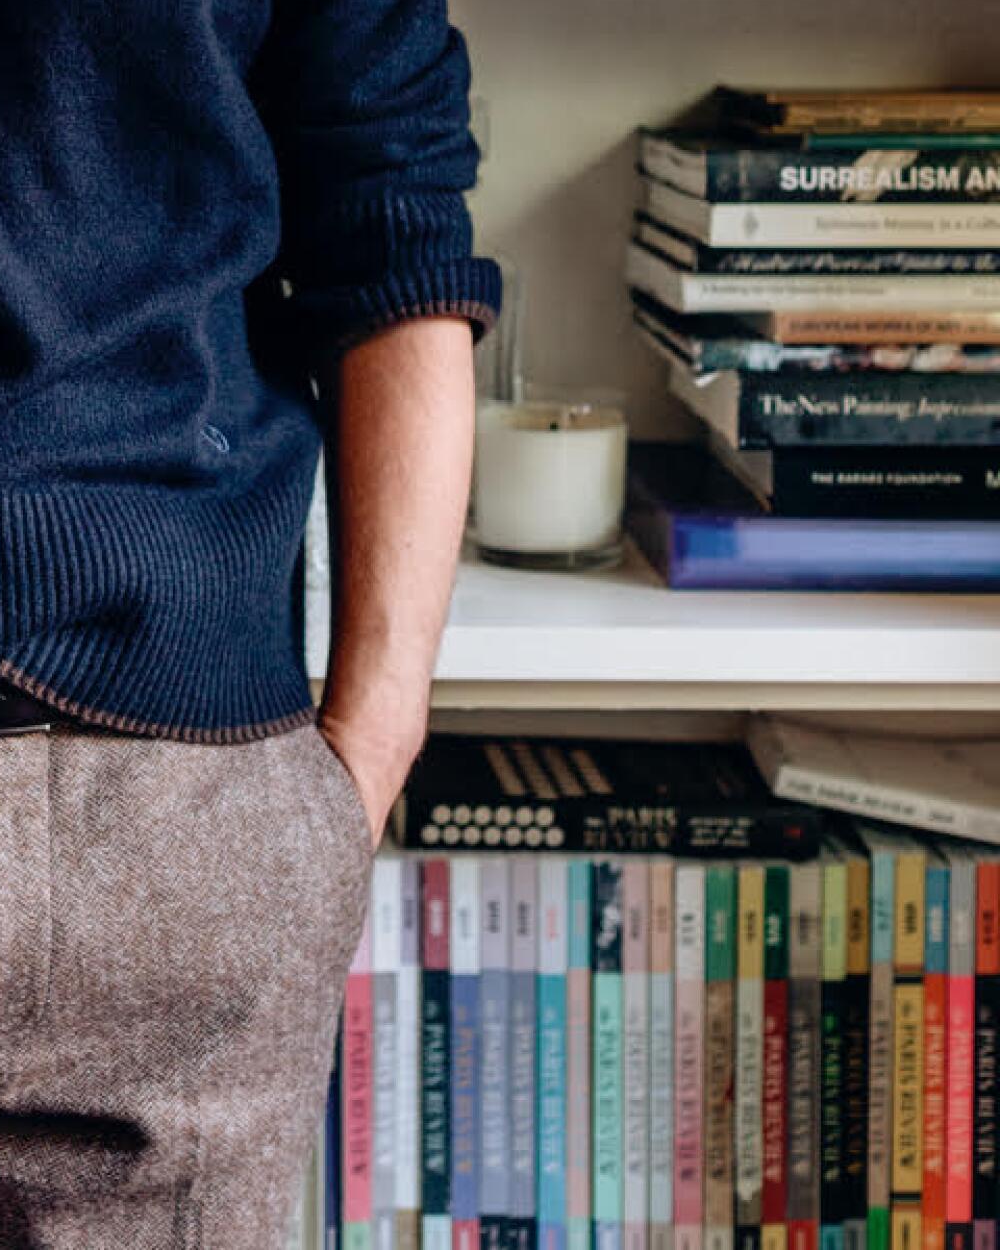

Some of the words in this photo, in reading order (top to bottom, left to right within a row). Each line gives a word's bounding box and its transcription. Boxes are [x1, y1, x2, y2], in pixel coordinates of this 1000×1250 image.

[780, 165, 960, 191] SURREALISM
[758, 394, 798, 415] The
[799, 394, 840, 415] New
